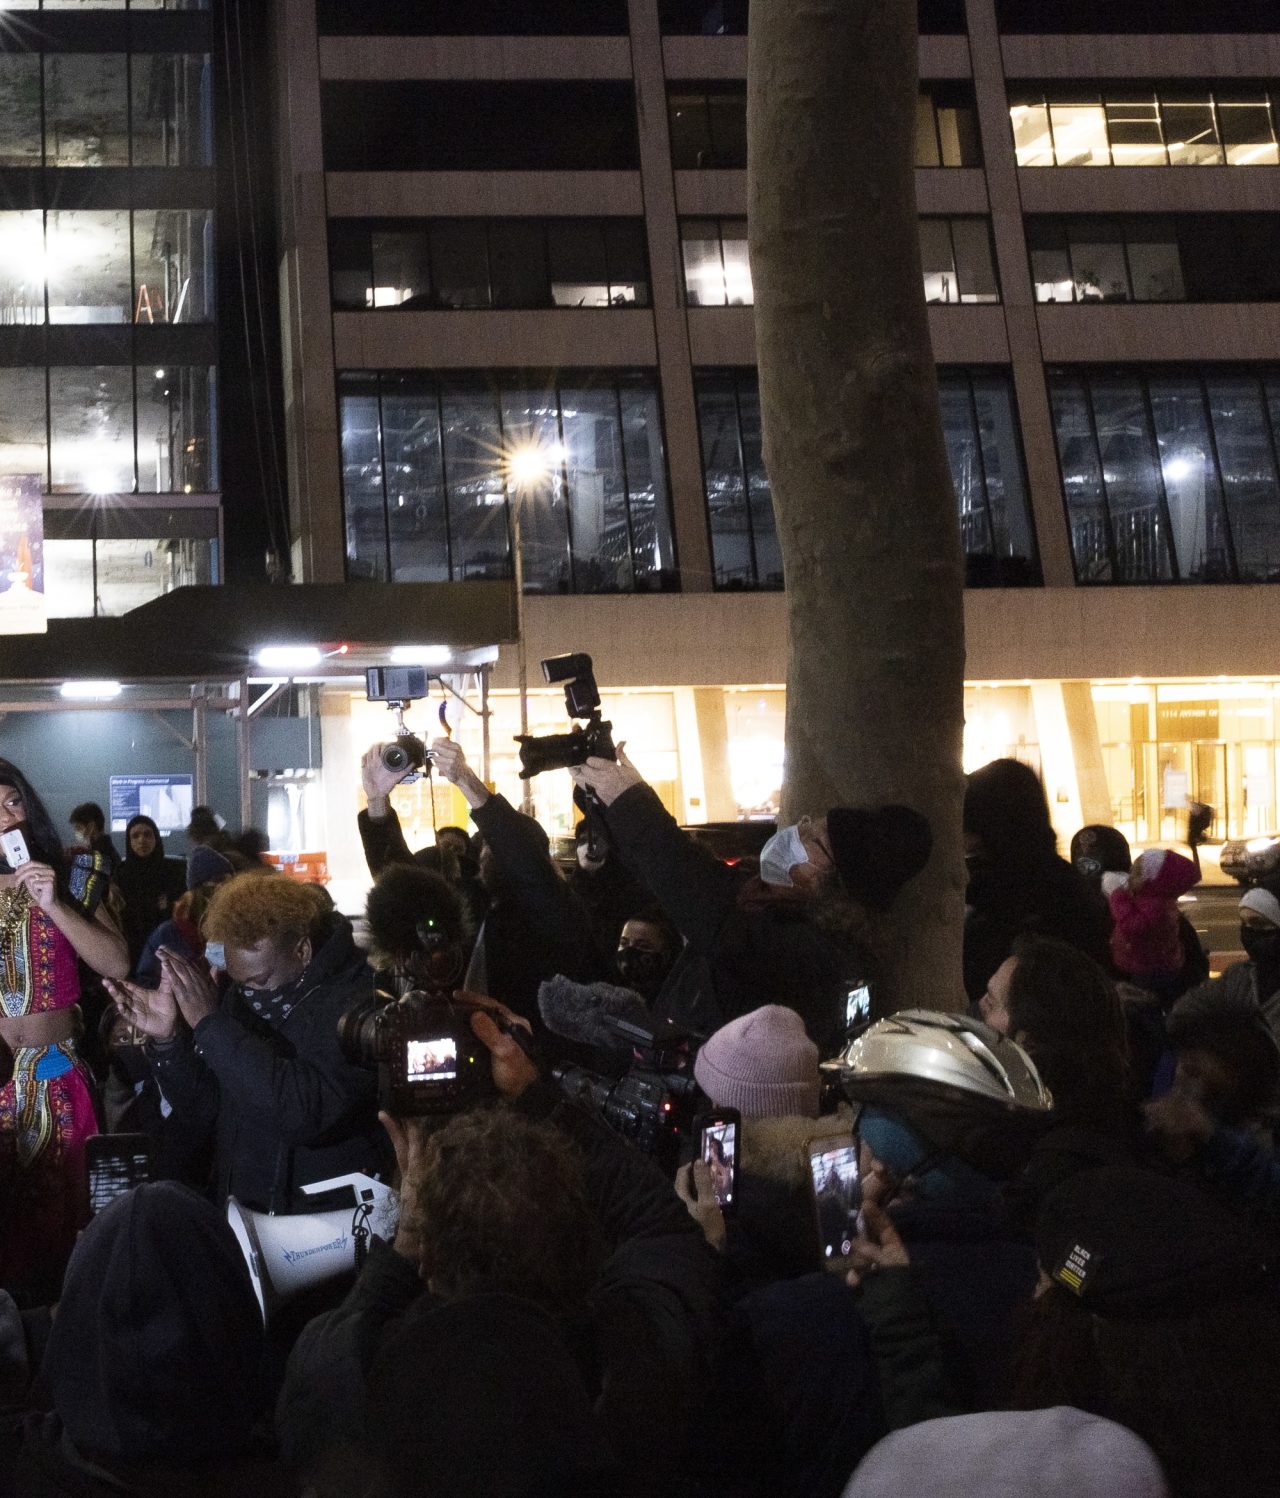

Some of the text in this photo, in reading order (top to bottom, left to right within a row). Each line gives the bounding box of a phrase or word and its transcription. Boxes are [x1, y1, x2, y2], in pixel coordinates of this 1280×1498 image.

[1069, 1251, 1086, 1267] LIVES
[1073, 1244, 1091, 1260] BLACK
[1065, 1259, 1087, 1279] MATTER
